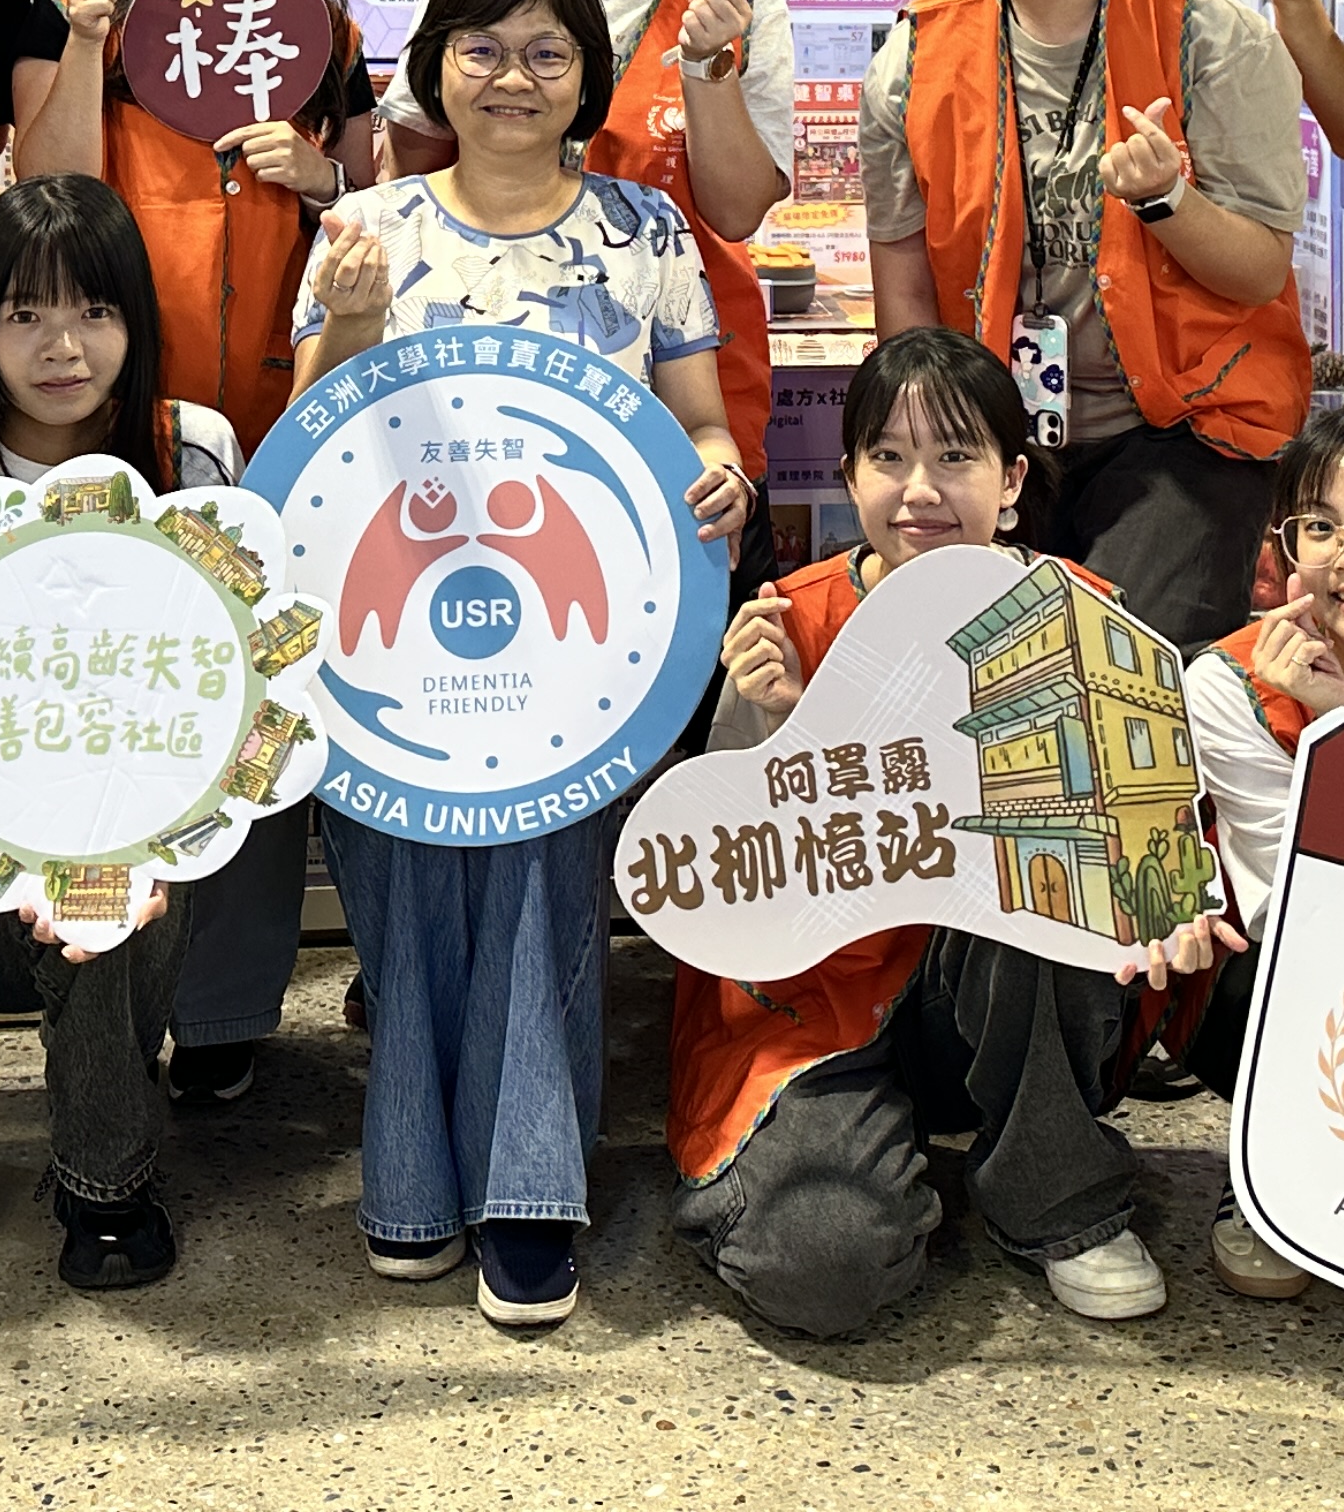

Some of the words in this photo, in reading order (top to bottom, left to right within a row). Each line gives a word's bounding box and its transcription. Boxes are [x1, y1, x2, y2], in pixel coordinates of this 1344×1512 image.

[793, 83, 863, 103] 健智桌
[296, 336, 644, 439] 亞洲大學社會責任實踐
[420, 438, 525, 464] 友善失智
[440, 599, 515, 630] USR
[422, 672, 533, 695] DEMENTIA
[428, 694, 529, 715] FRIENDLY
[764, 737, 932, 808] 阿罩霧
[324, 769, 410, 827] ASIA
[424, 746, 641, 836] UNIVERSITY
[628, 803, 956, 915] 北柳憶站
